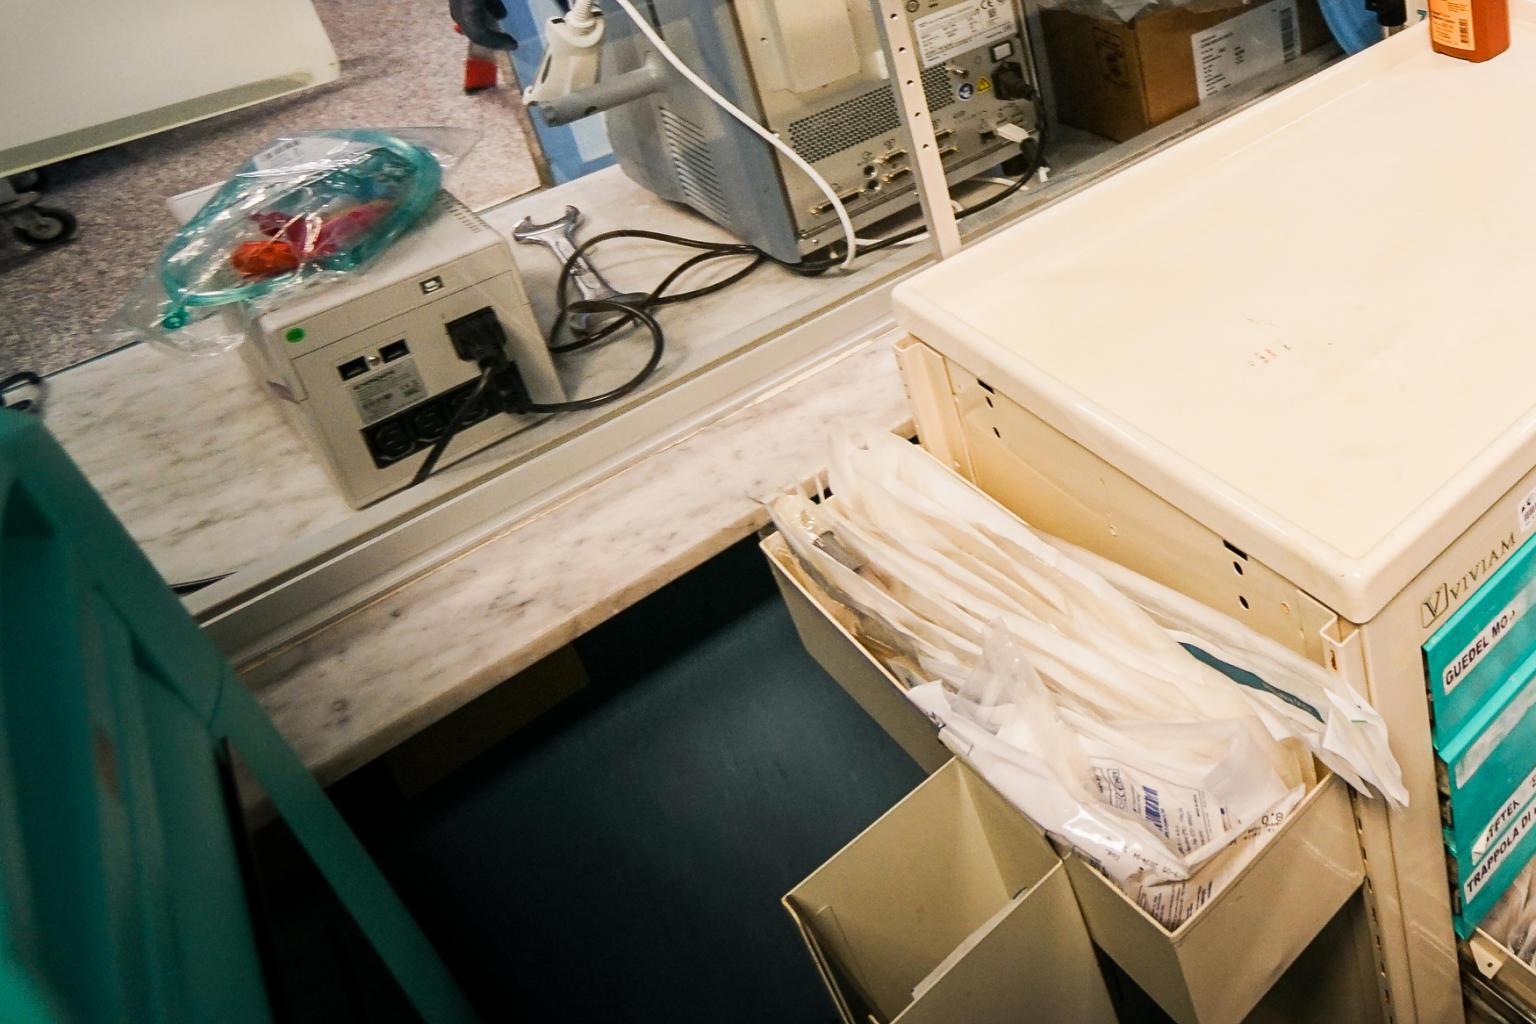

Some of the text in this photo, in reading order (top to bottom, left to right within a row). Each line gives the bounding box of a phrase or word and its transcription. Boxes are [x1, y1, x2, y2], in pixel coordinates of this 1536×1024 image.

[1449, 531, 1516, 601] VIVIAM
[1445, 636, 1489, 686] GUEDEL
[1466, 826, 1520, 893] TRAPPOLA
[1521, 812, 1531, 830] DI
